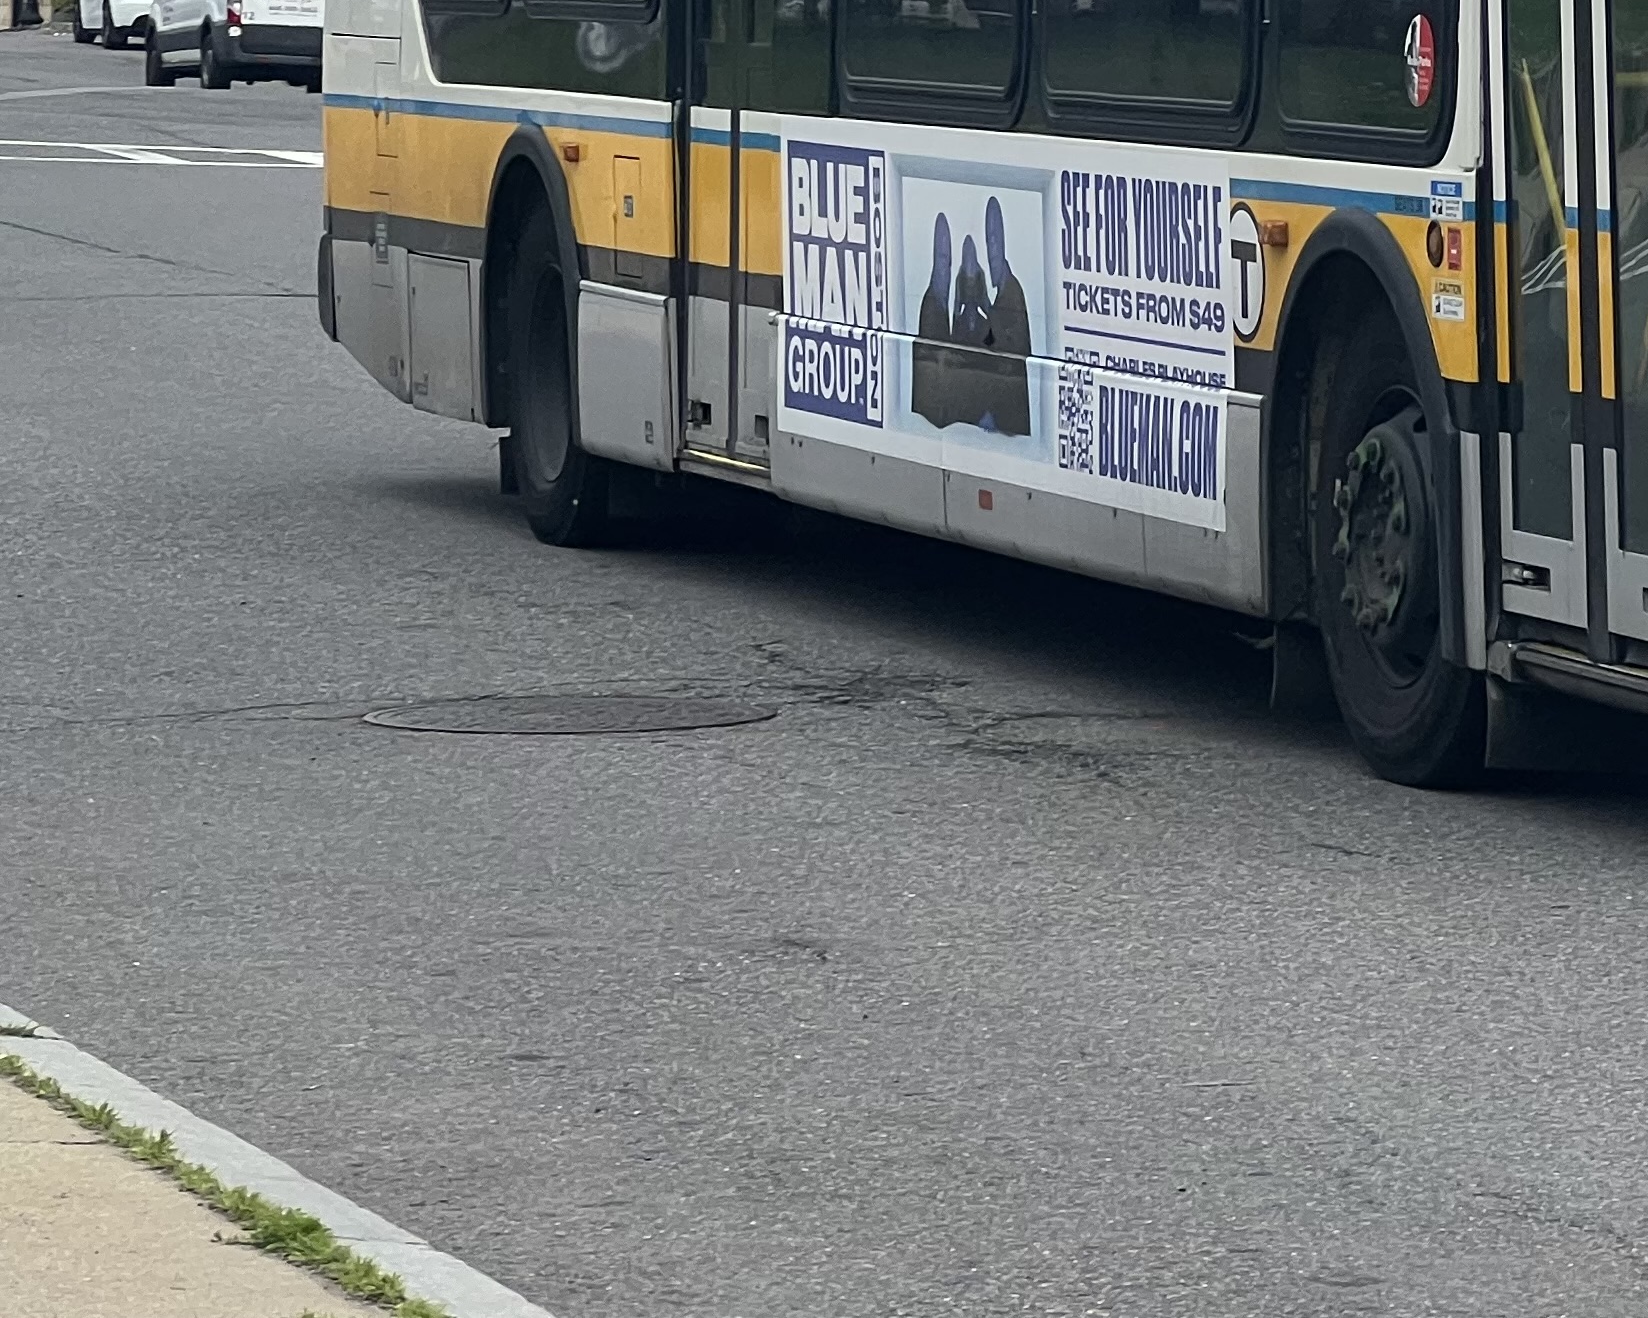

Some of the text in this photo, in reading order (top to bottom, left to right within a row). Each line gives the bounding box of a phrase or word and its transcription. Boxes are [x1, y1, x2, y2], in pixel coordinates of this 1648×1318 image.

[791, 156, 867, 245] BLUE
[1061, 169, 1223, 291] SEE FOR YOURSELF
[792, 240, 868, 338] MAN
[1063, 281, 1225, 333] TICKETS FROM $49
[1231, 239, 1257, 319] T
[788, 339, 864, 406] GROUP
[1105, 353, 1226, 388] CHARLES PLAYHOUSE
[1099, 383, 1219, 501] BLUEMAN.COM
